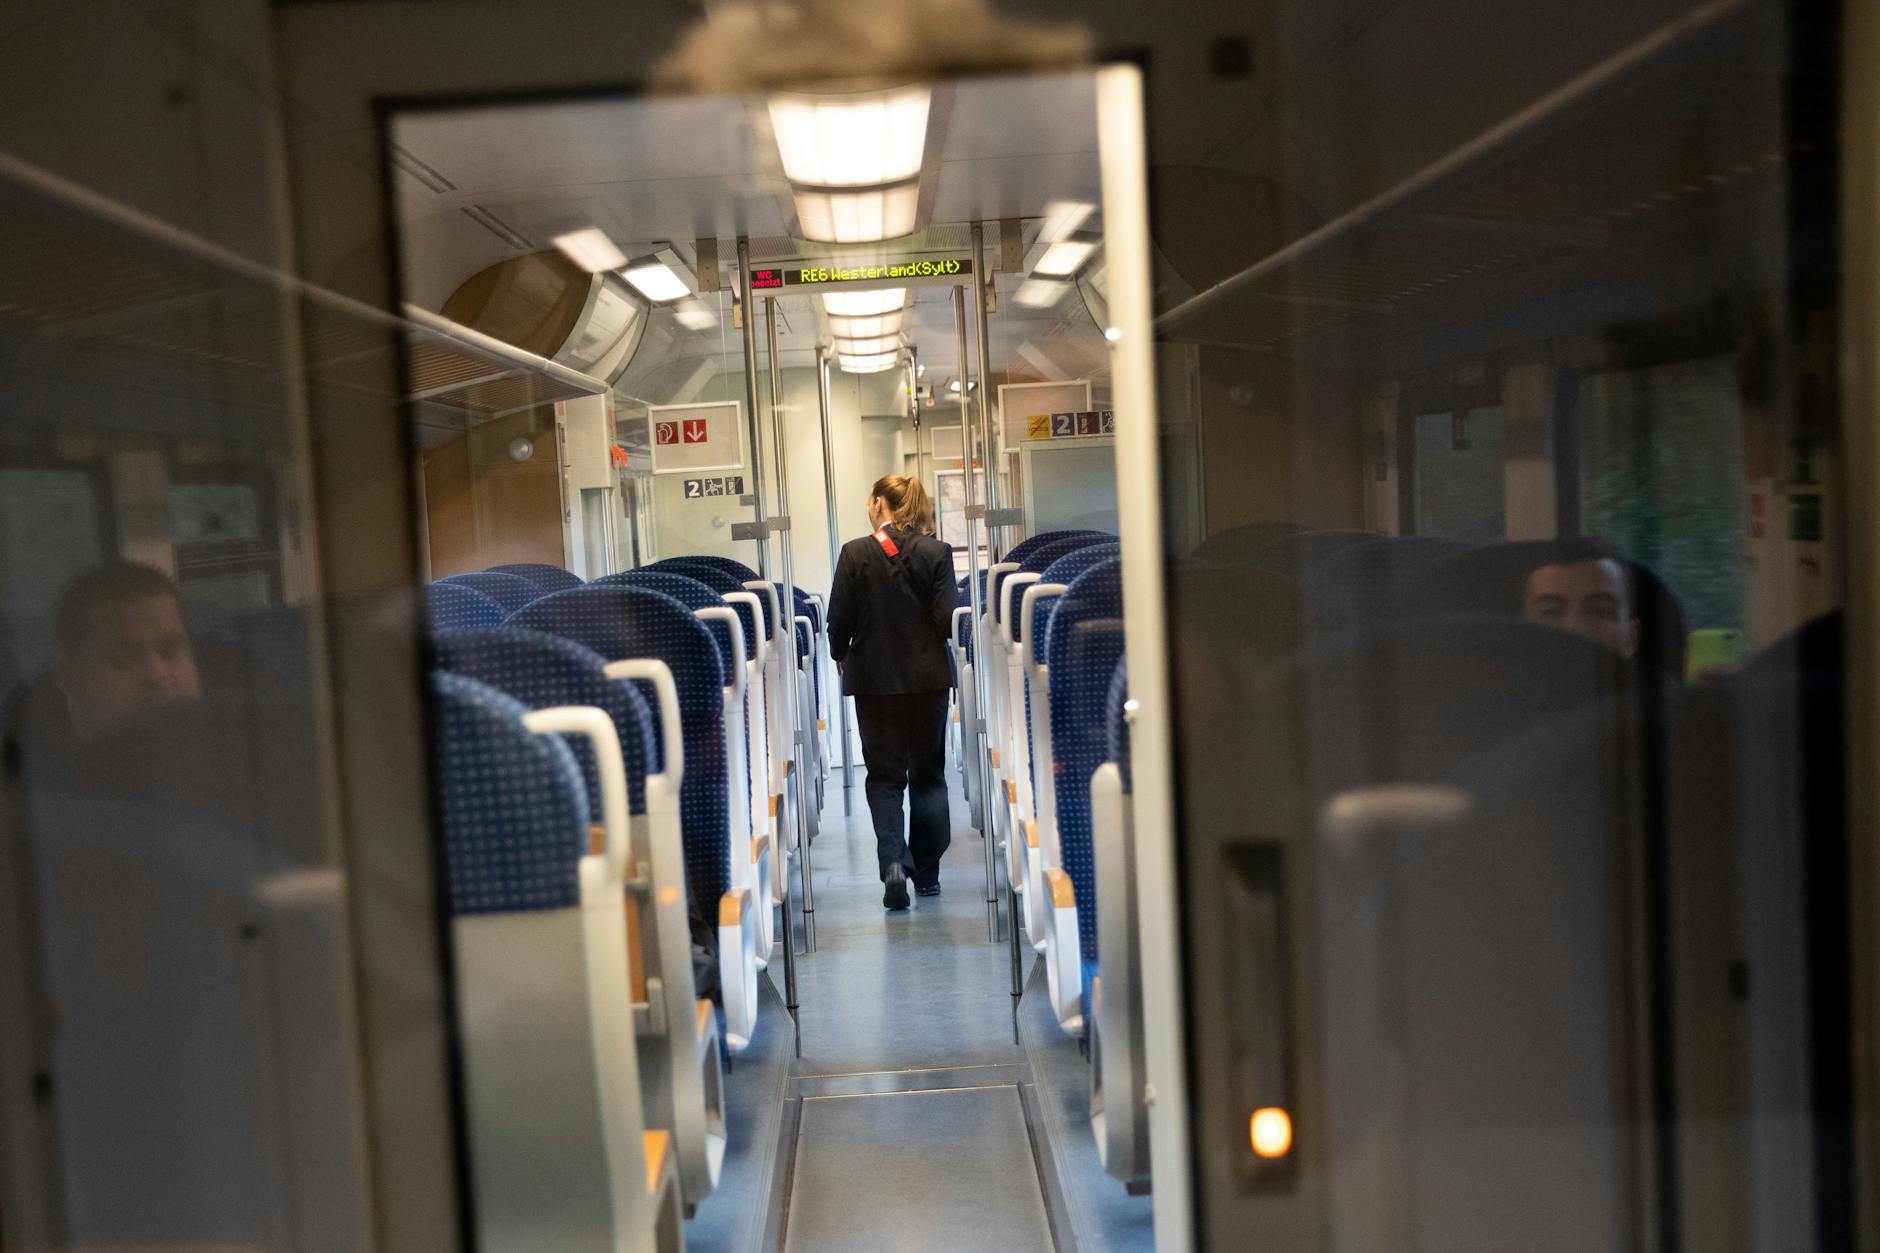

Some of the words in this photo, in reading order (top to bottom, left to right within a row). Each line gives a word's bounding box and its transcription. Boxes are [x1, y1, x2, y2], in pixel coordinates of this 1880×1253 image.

[756, 271, 772, 279] WC
[800, 268, 828, 282] RE6
[1056, 415, 1070, 434] 2
[688, 481, 700, 497] 2
